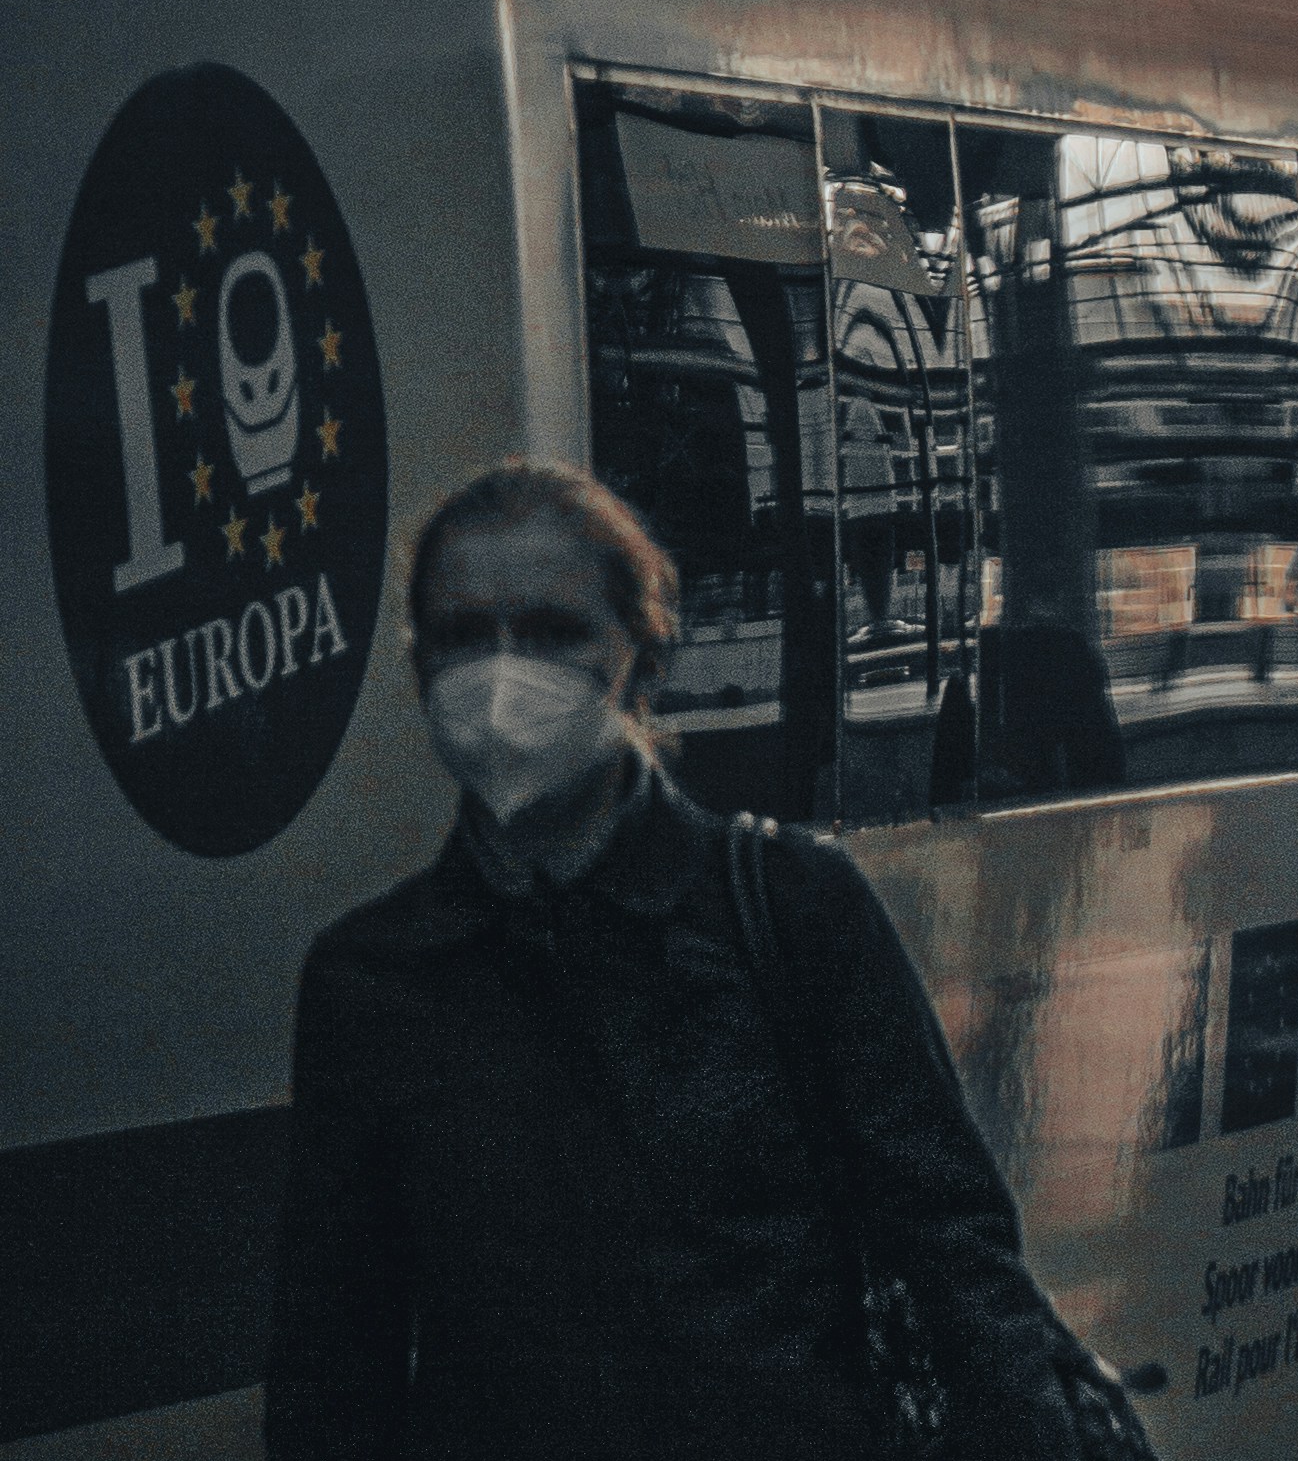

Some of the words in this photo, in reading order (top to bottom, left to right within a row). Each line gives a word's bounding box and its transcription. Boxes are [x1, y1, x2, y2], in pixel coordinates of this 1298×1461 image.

[85, 255, 187, 596] I
[123, 571, 349, 747] EUROPA
[1222, 1173, 1270, 1225] Bahn
[1201, 1260, 1259, 1324] Spoor
[1193, 1333, 1236, 1401] Rail
[1233, 1332, 1282, 1398] pour
